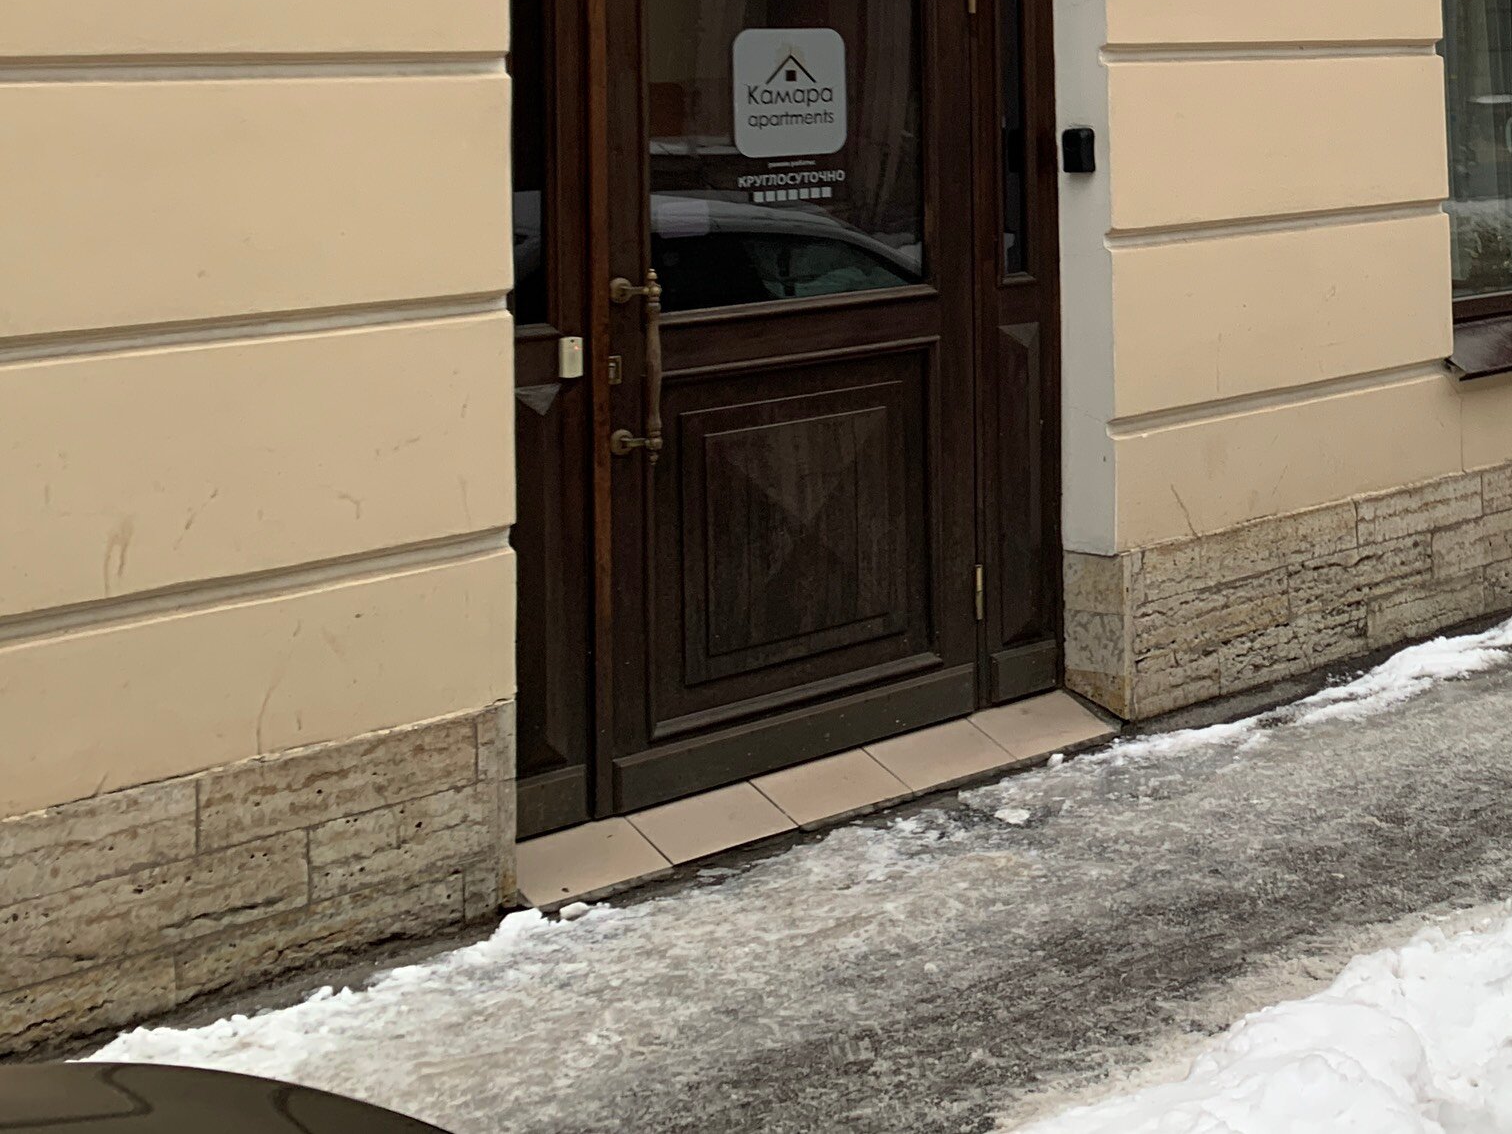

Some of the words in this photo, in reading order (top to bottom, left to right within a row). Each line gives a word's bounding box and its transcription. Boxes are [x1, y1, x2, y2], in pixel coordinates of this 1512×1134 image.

[746, 83, 834, 107] Камара
[748, 109, 835, 130] apartments
[737, 169, 846, 188] КРУГЛОСУТОЧНО
